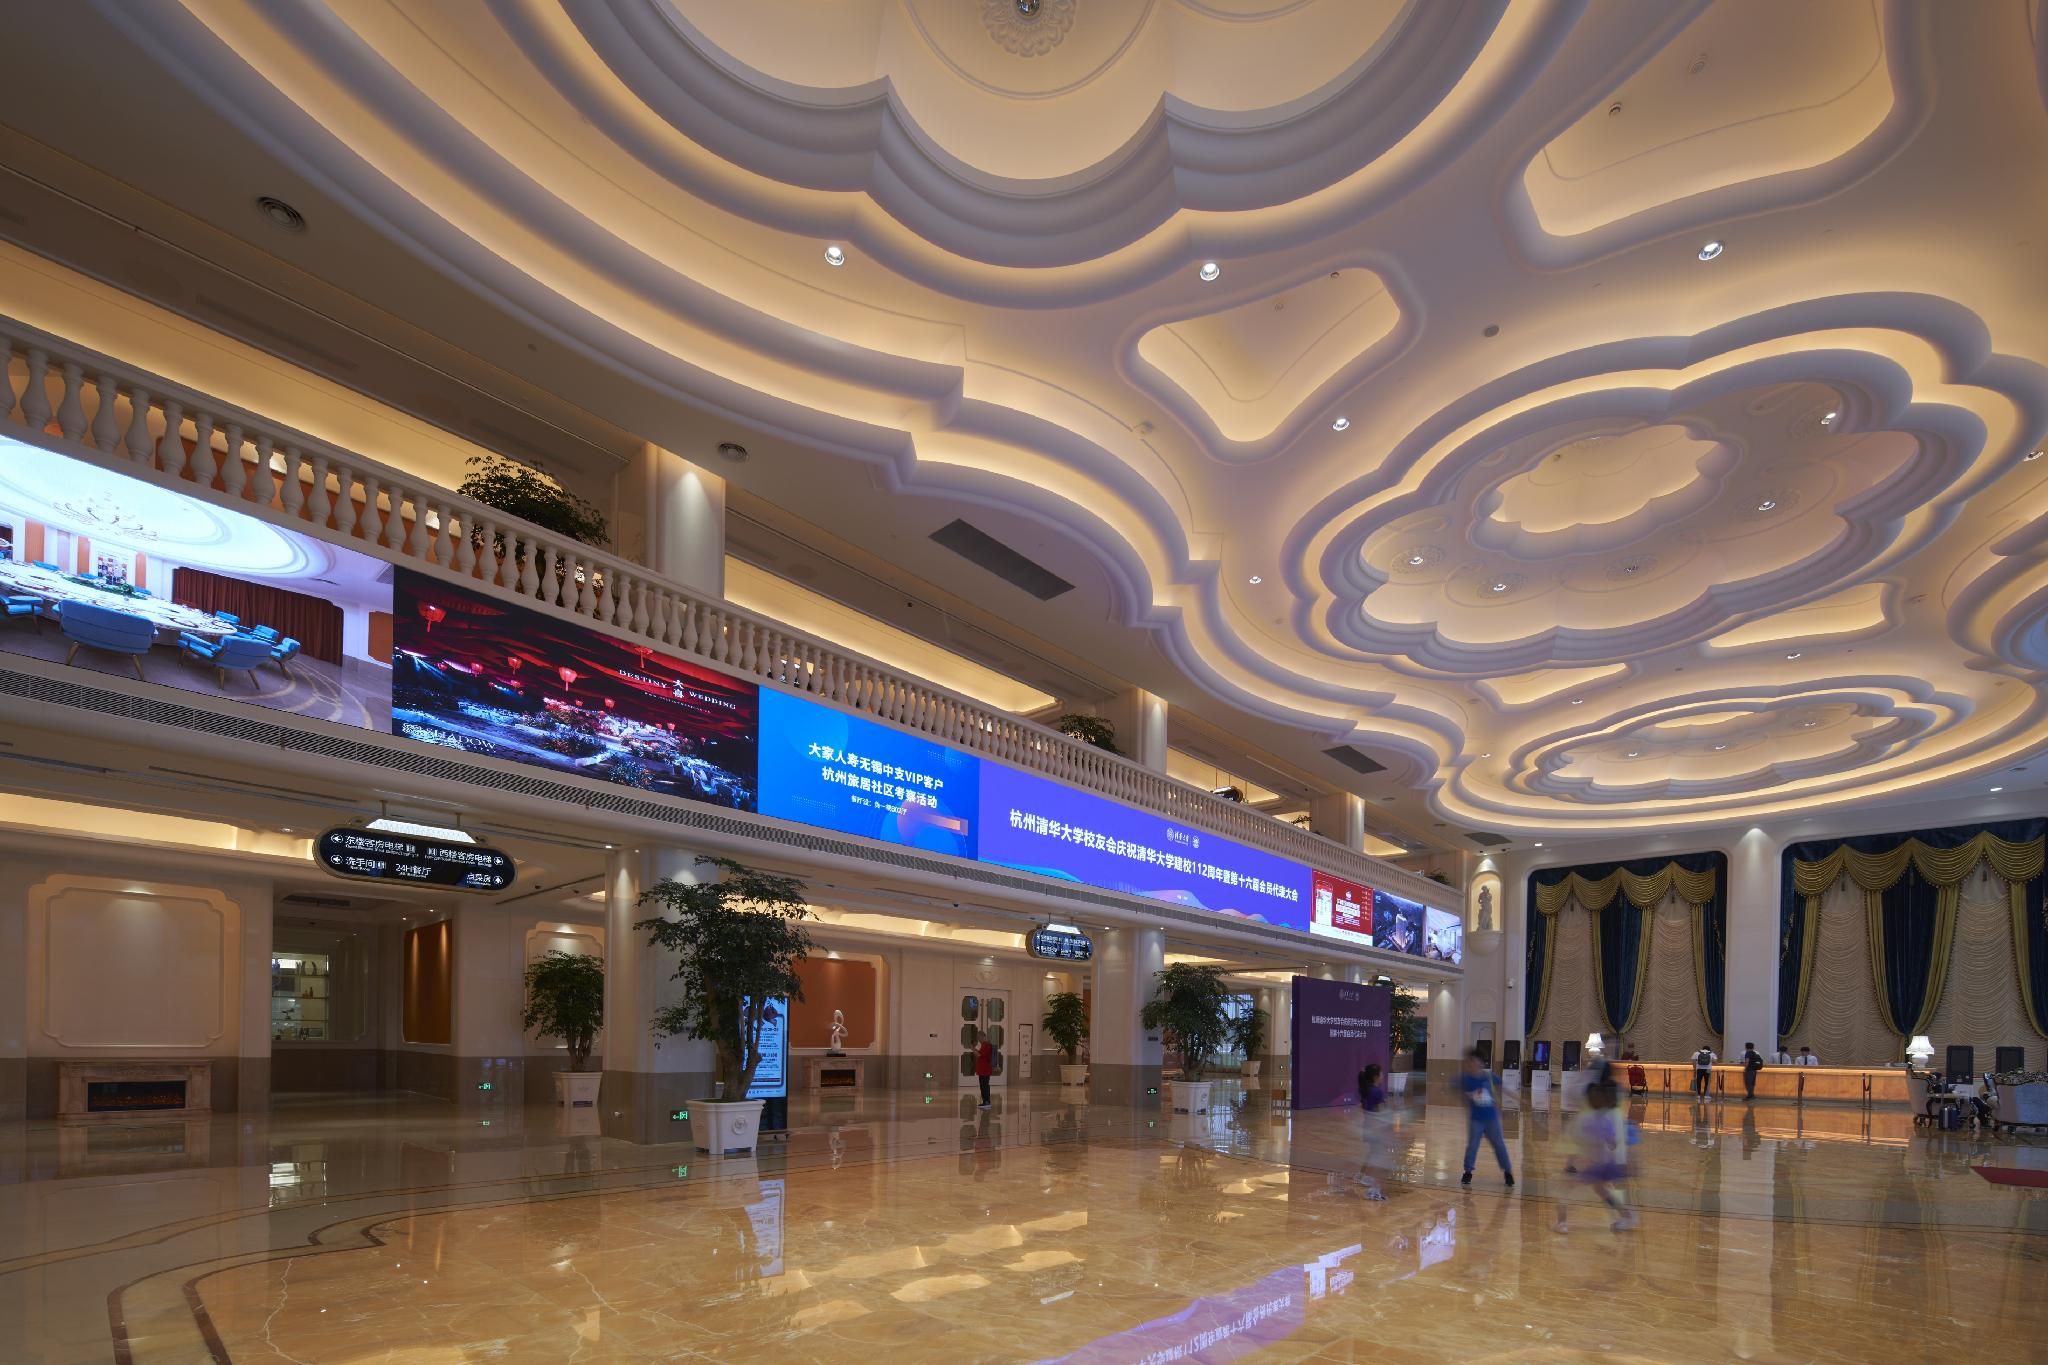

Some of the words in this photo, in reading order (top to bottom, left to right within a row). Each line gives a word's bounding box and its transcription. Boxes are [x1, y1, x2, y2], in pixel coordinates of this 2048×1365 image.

[619, 669, 669, 689] DESTINY
[689, 691, 736, 710] WEDDING
[808, 742, 944, 791] 大家人寿无锡中支VIP客户
[822, 765, 938, 809] 杭州旅居社区考察活动
[1009, 808, 1299, 902] 杭州清华大学校友会庆祝清华大学建校112周年暨第十六届会员代表大会
